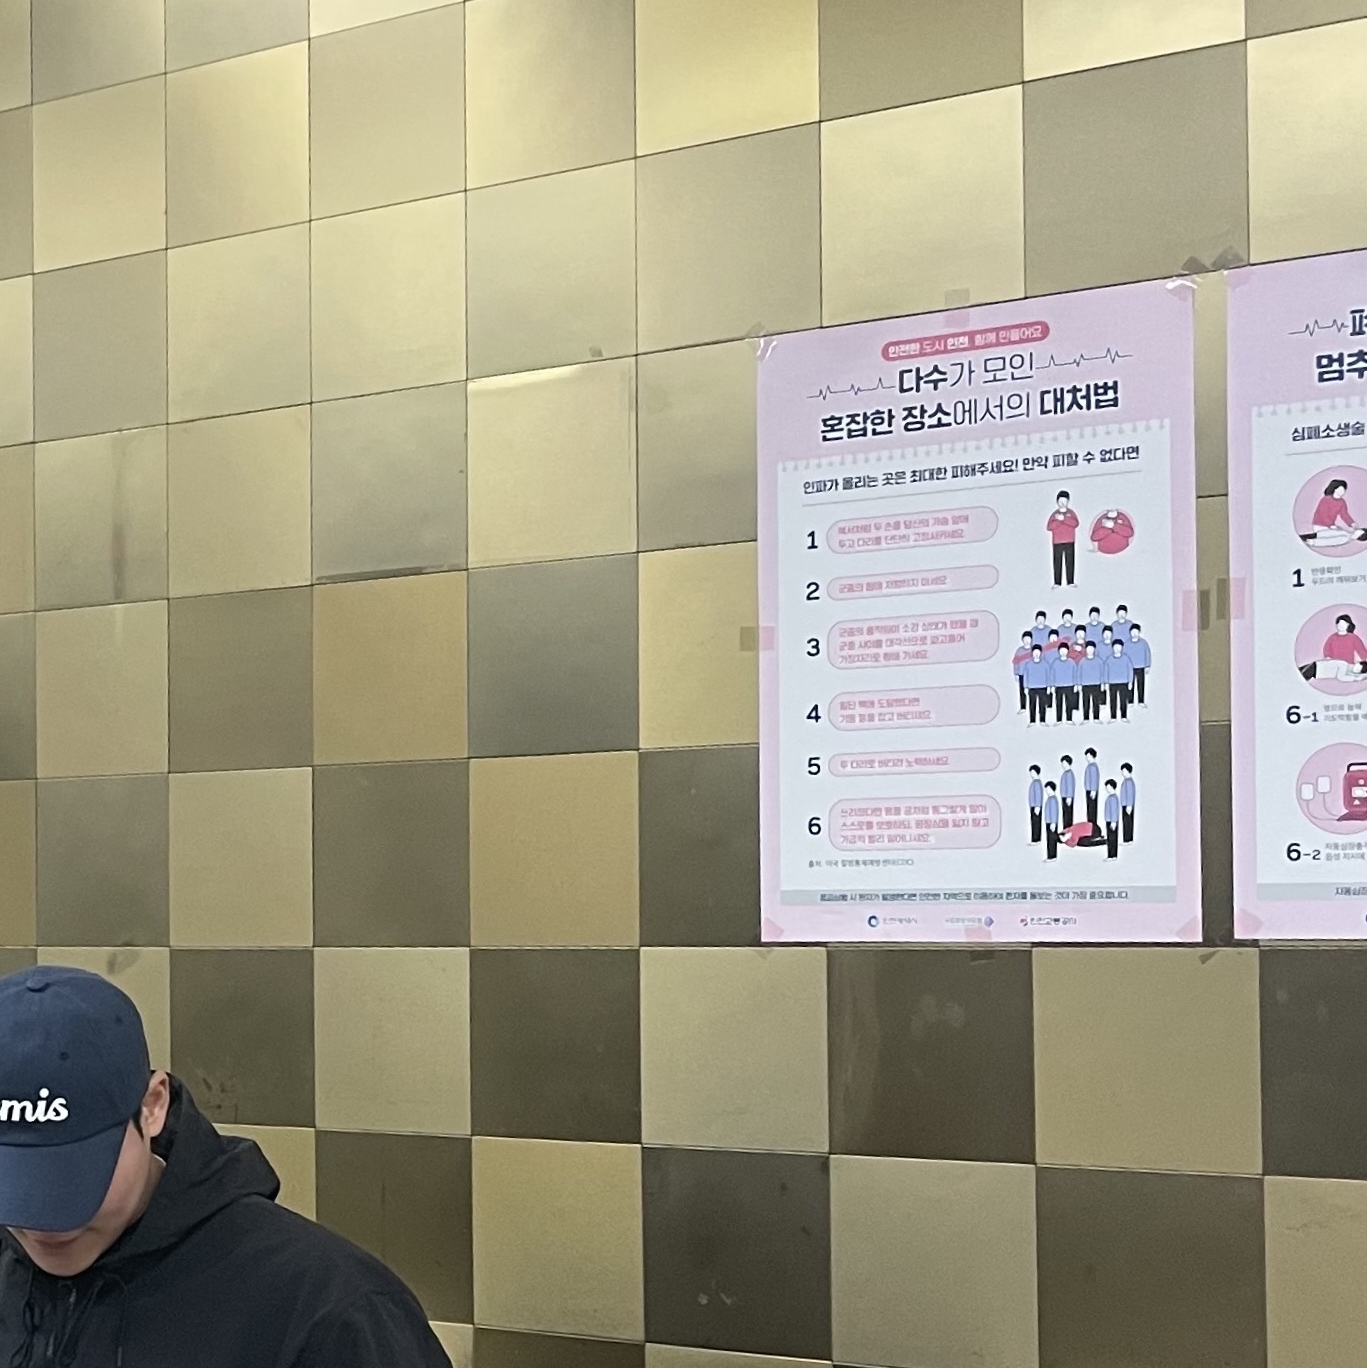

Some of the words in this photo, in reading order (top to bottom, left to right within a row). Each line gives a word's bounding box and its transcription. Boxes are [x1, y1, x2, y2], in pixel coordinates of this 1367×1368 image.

[888, 343, 920, 358] 안전한
[922, 339, 945, 353] 도시
[898, 358, 976, 394] 다수가
[982, 351, 1034, 385] 모인
[820, 408, 895, 442] 혼잡한
[901, 390, 1031, 433] 장소에서의
[1038, 380, 1120, 416] 대처법
[1292, 421, 1365, 441] 심폐소생술
[803, 477, 840, 495] 인파가
[842, 473, 879, 491] 몰리는
[882, 471, 907, 486] 곳은
[909, 466, 948, 483] 최대한
[951, 458, 1020, 478] 피해주세요!
[1022, 456, 1049, 472] 만약
[1052, 453, 1079, 469] 피할
[1082, 450, 1096, 465] 수
[1099, 444, 1141, 463] 없다면
[806, 530, 819, 550] 1
[1292, 568, 1305, 588] 1
[805, 581, 821, 601] 2
[806, 637, 821, 657] 3
[805, 703, 822, 723] 4
[1286, 704, 1319, 725] 6-1
[807, 756, 822, 776] 5
[807, 816, 822, 836] 6
[1286, 842, 1321, 862] 6-2
